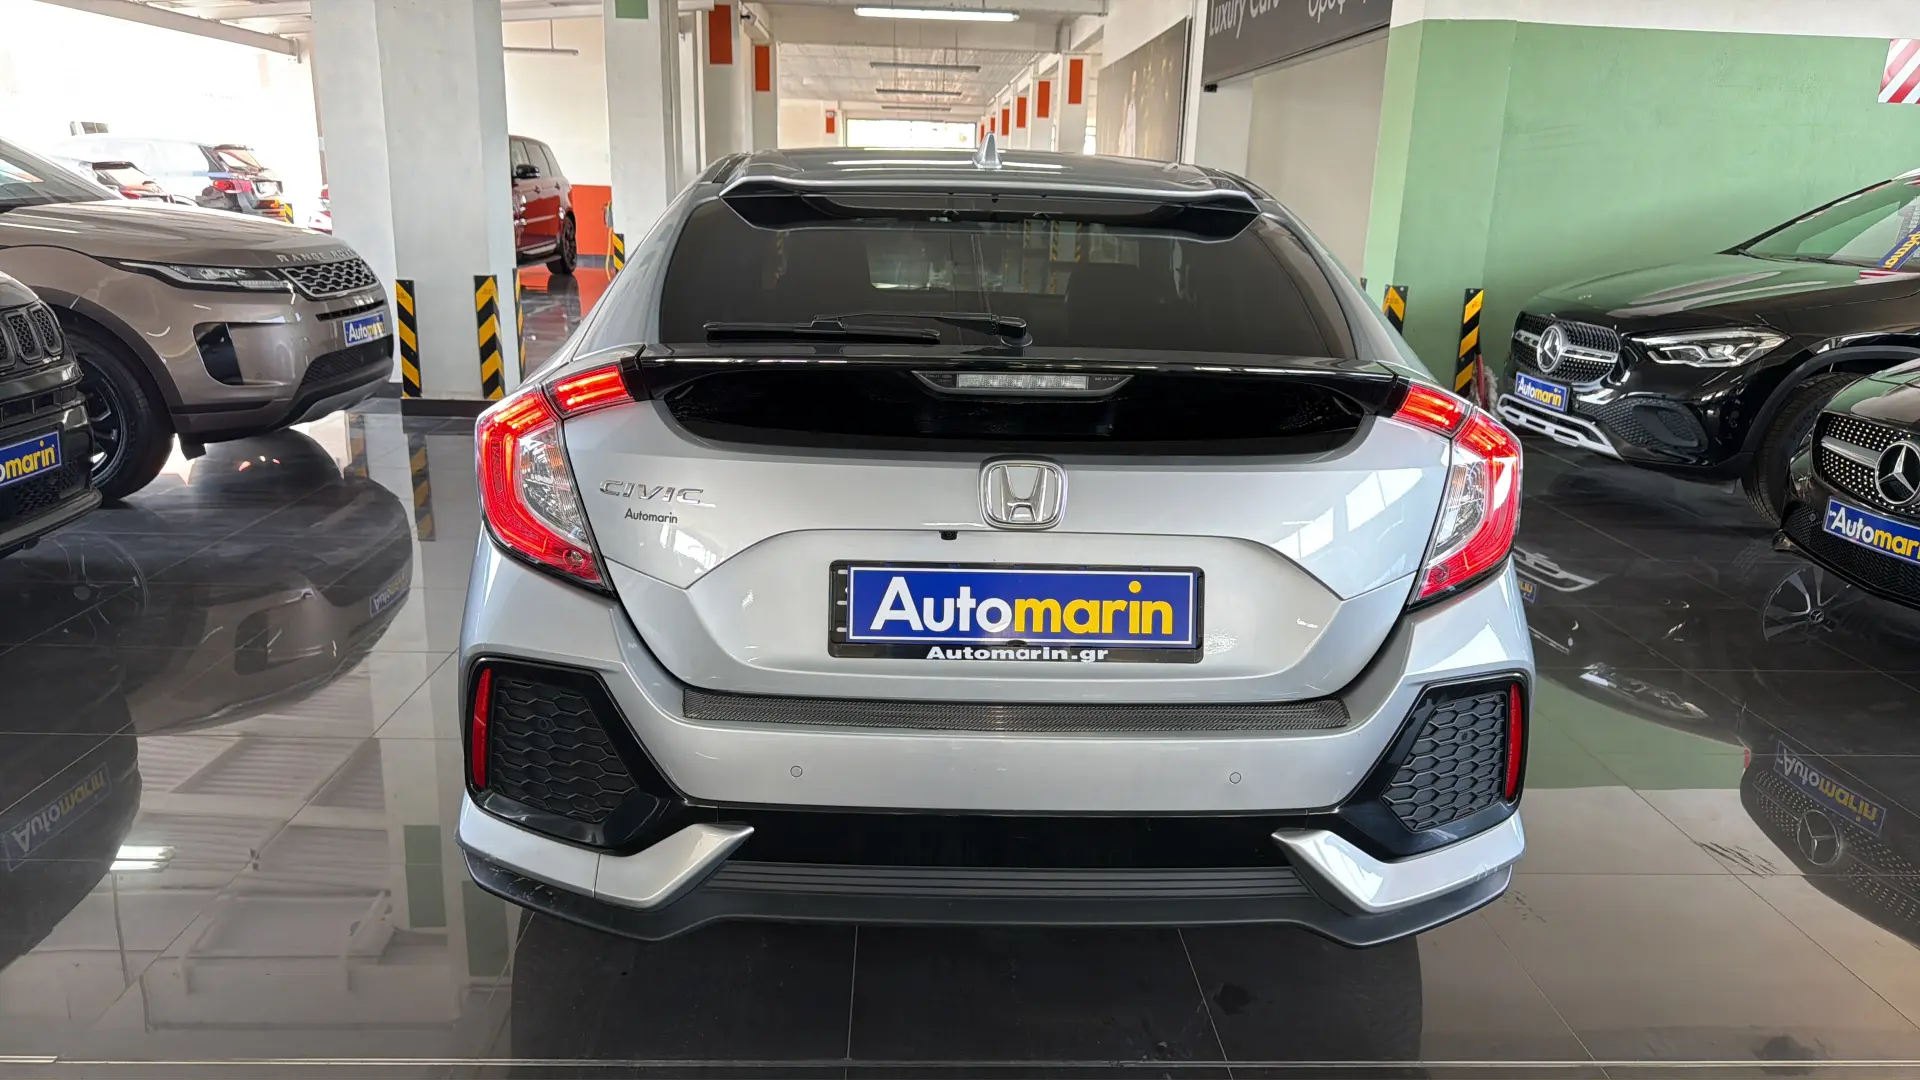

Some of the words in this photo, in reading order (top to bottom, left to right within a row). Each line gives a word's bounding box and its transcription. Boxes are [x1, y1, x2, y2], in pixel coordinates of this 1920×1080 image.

[1208, 0, 1247, 39] Luxury
[276, 252, 326, 263] RANGE
[1517, 376, 1562, 407] Automarin
[599, 480, 704, 504] CIVIC
[624, 508, 678, 524] Automarin
[1830, 507, 1920, 560] Automar
[869, 576, 1174, 635] Automarin
[926, 646, 1109, 664] Automarin.gr
